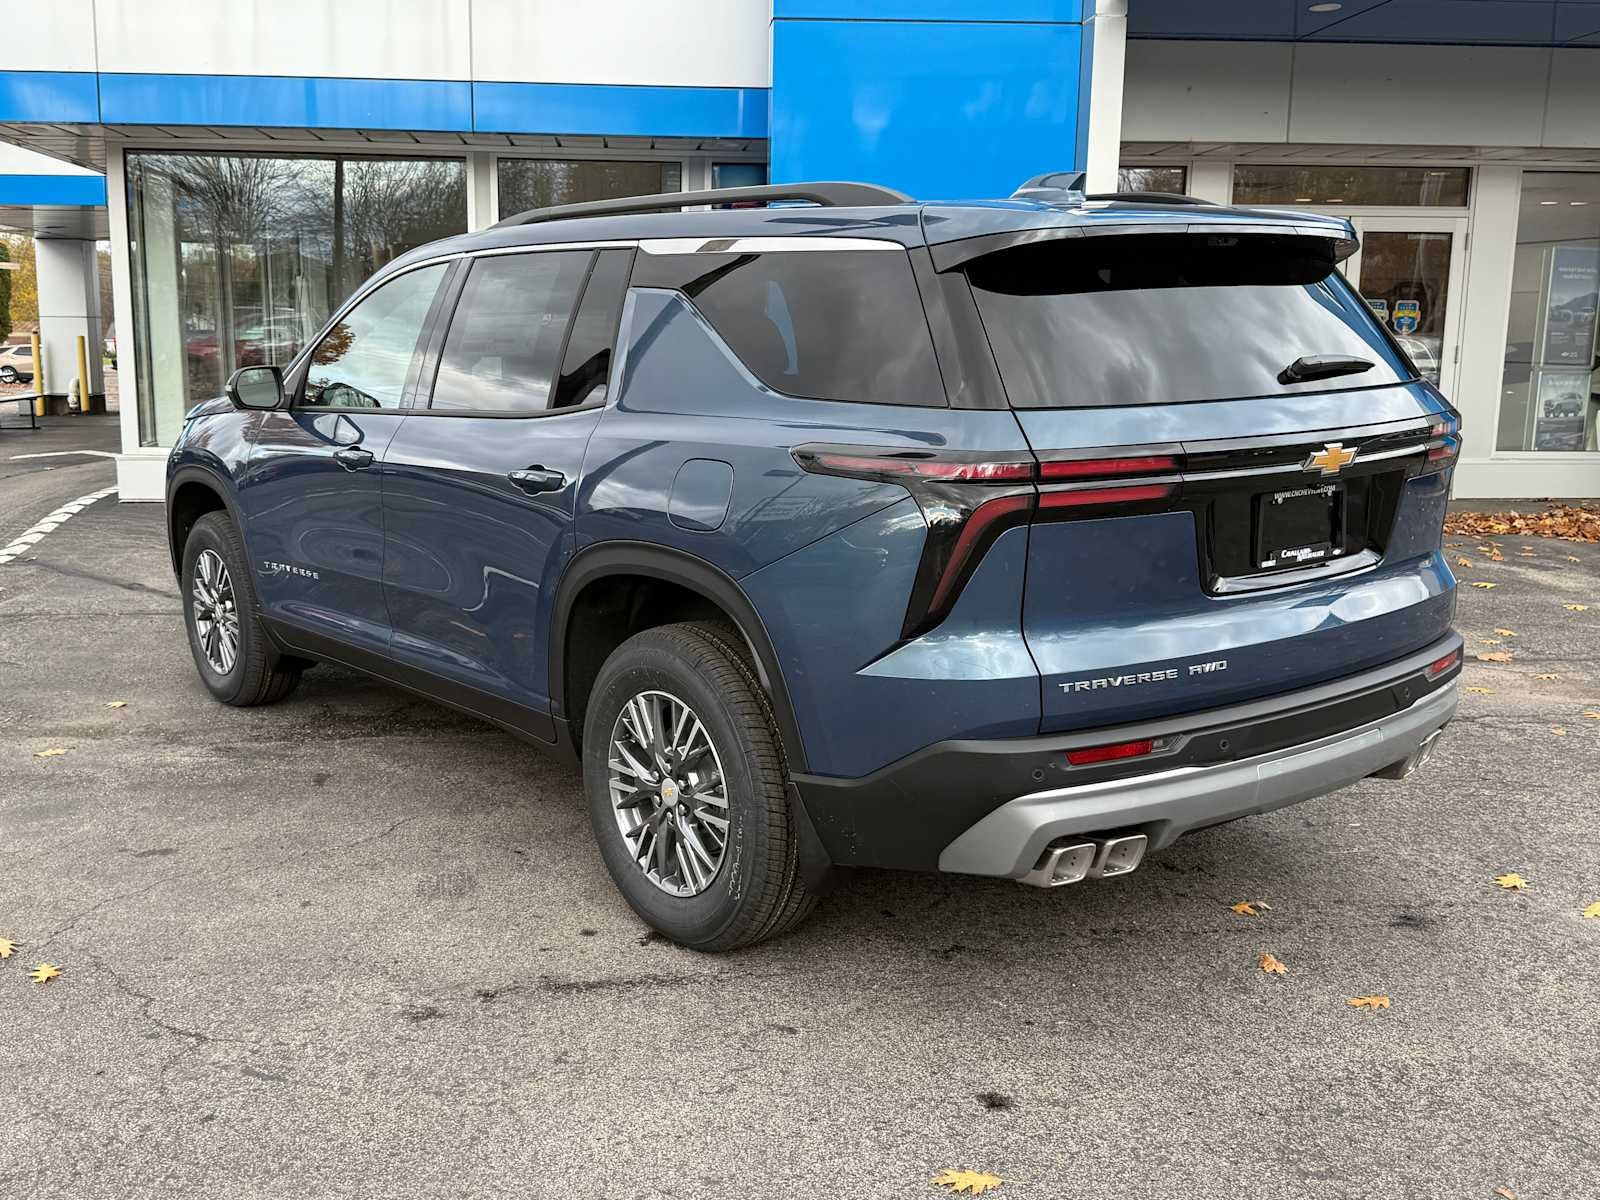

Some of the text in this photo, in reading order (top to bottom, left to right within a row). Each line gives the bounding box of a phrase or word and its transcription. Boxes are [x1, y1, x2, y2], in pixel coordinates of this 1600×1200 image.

[264, 561, 319, 580] TRAVERSE
[1058, 659, 1228, 693] TRAVERSE AWD
